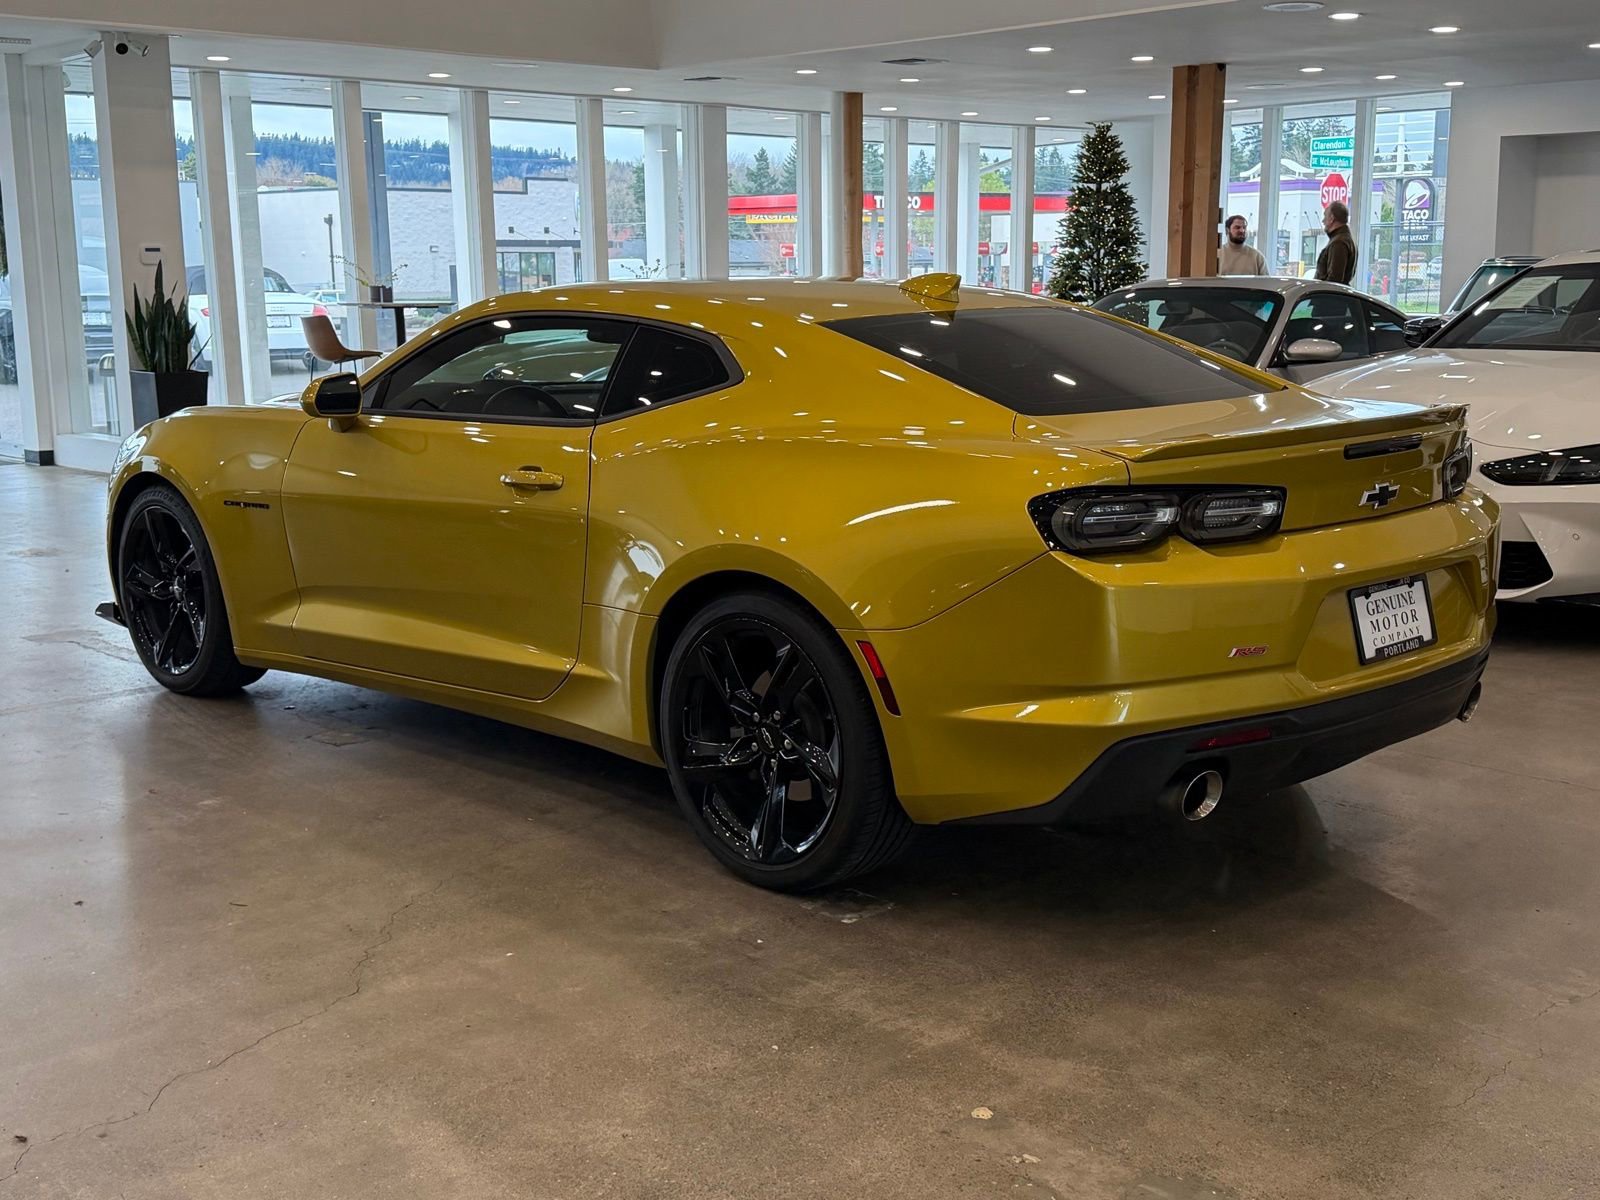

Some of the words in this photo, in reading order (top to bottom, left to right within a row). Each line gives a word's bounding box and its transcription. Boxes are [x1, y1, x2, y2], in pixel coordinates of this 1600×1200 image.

[1313, 140, 1346, 150] Clarendon
[1349, 139, 1354, 148] S
[1322, 186, 1346, 203] STOP
[1402, 209, 1429, 220] TACO
[1366, 590, 1415, 616] GENUINE
[1369, 609, 1418, 634] MOTOR
[1373, 626, 1420, 647] COMPANY
[1383, 638, 1420, 658] PORTLAND
